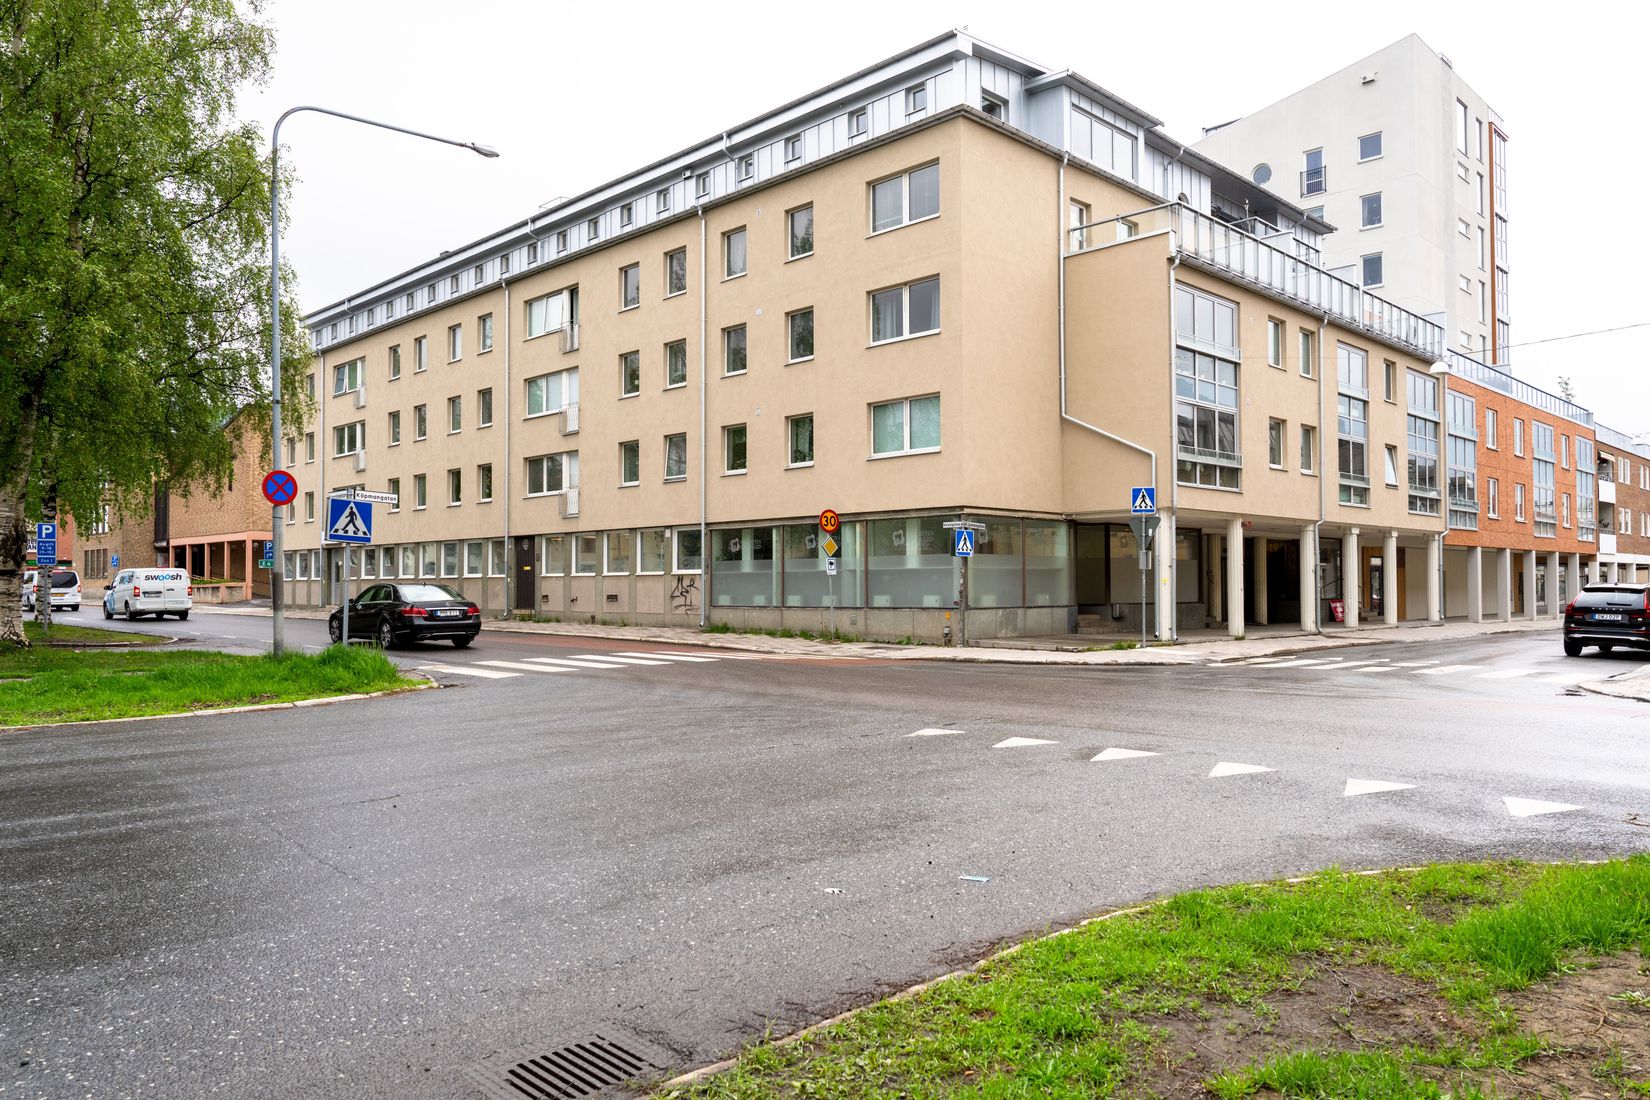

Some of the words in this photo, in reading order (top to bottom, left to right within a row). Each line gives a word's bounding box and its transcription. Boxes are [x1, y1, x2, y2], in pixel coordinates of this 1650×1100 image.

[356, 492, 397, 502] Köpmangatan
[823, 515, 837, 527] 30
[42, 525, 53, 538] P
[266, 542, 273, 550] P
[144, 573, 182, 581] swoosh
